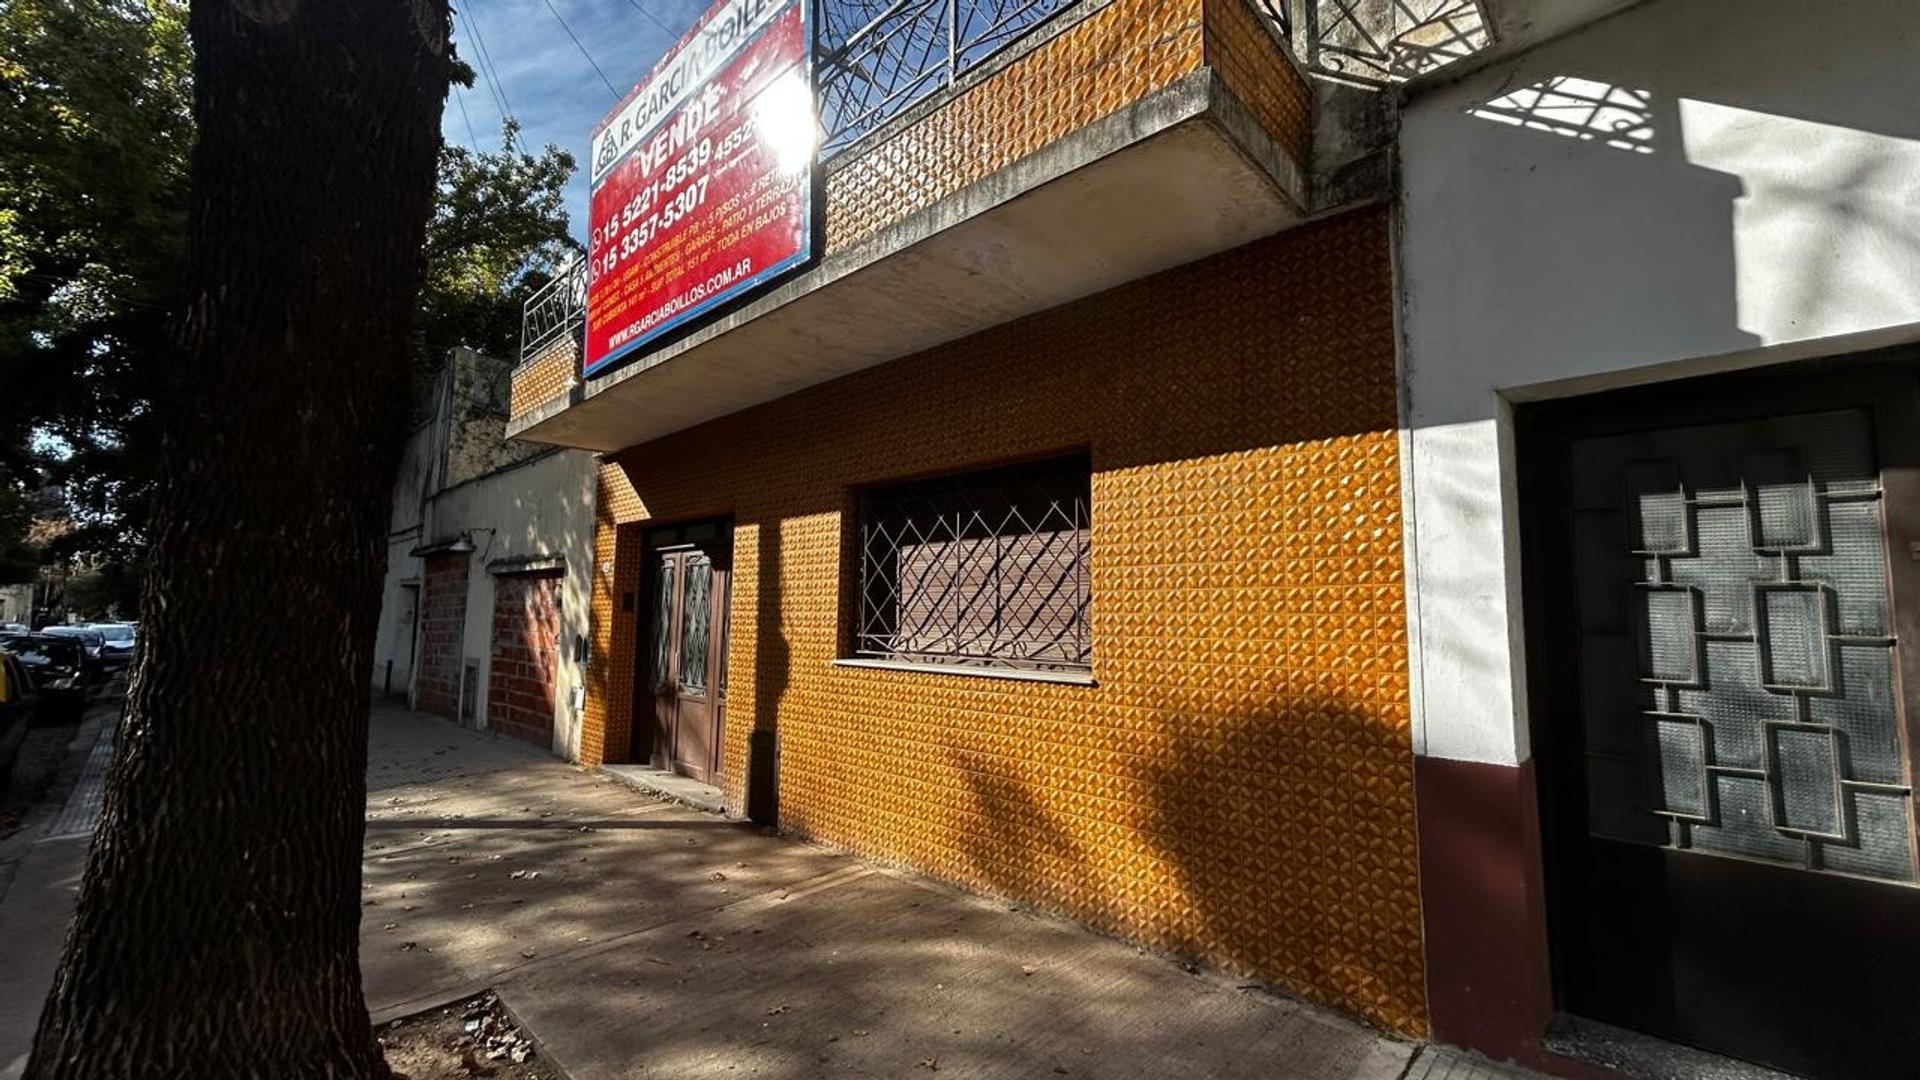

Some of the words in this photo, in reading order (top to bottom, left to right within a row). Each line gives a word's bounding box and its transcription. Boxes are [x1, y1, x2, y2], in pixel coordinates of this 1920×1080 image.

[621, 119, 632, 147] R.
[636, 50, 700, 131] GARCIA
[705, 0, 771, 65] BOILL
[640, 84, 722, 178] VENDE
[602, 246, 617, 275] 15
[621, 174, 709, 260] 3357-5307
[604, 213, 619, 243] 15
[622, 137, 711, 227] 5221-8539
[685, 226, 716, 255] GARAGE
[722, 207, 746, 233] PATIO
[756, 173, 798, 212] TERRAZA
[715, 193, 740, 221] PISOS
[718, 229, 739, 251] TODA
[741, 220, 753, 239] EN
[755, 201, 786, 231] BAJOS
[608, 257, 751, 349] WWW.RGARCIABOILLOS.COM.AR
